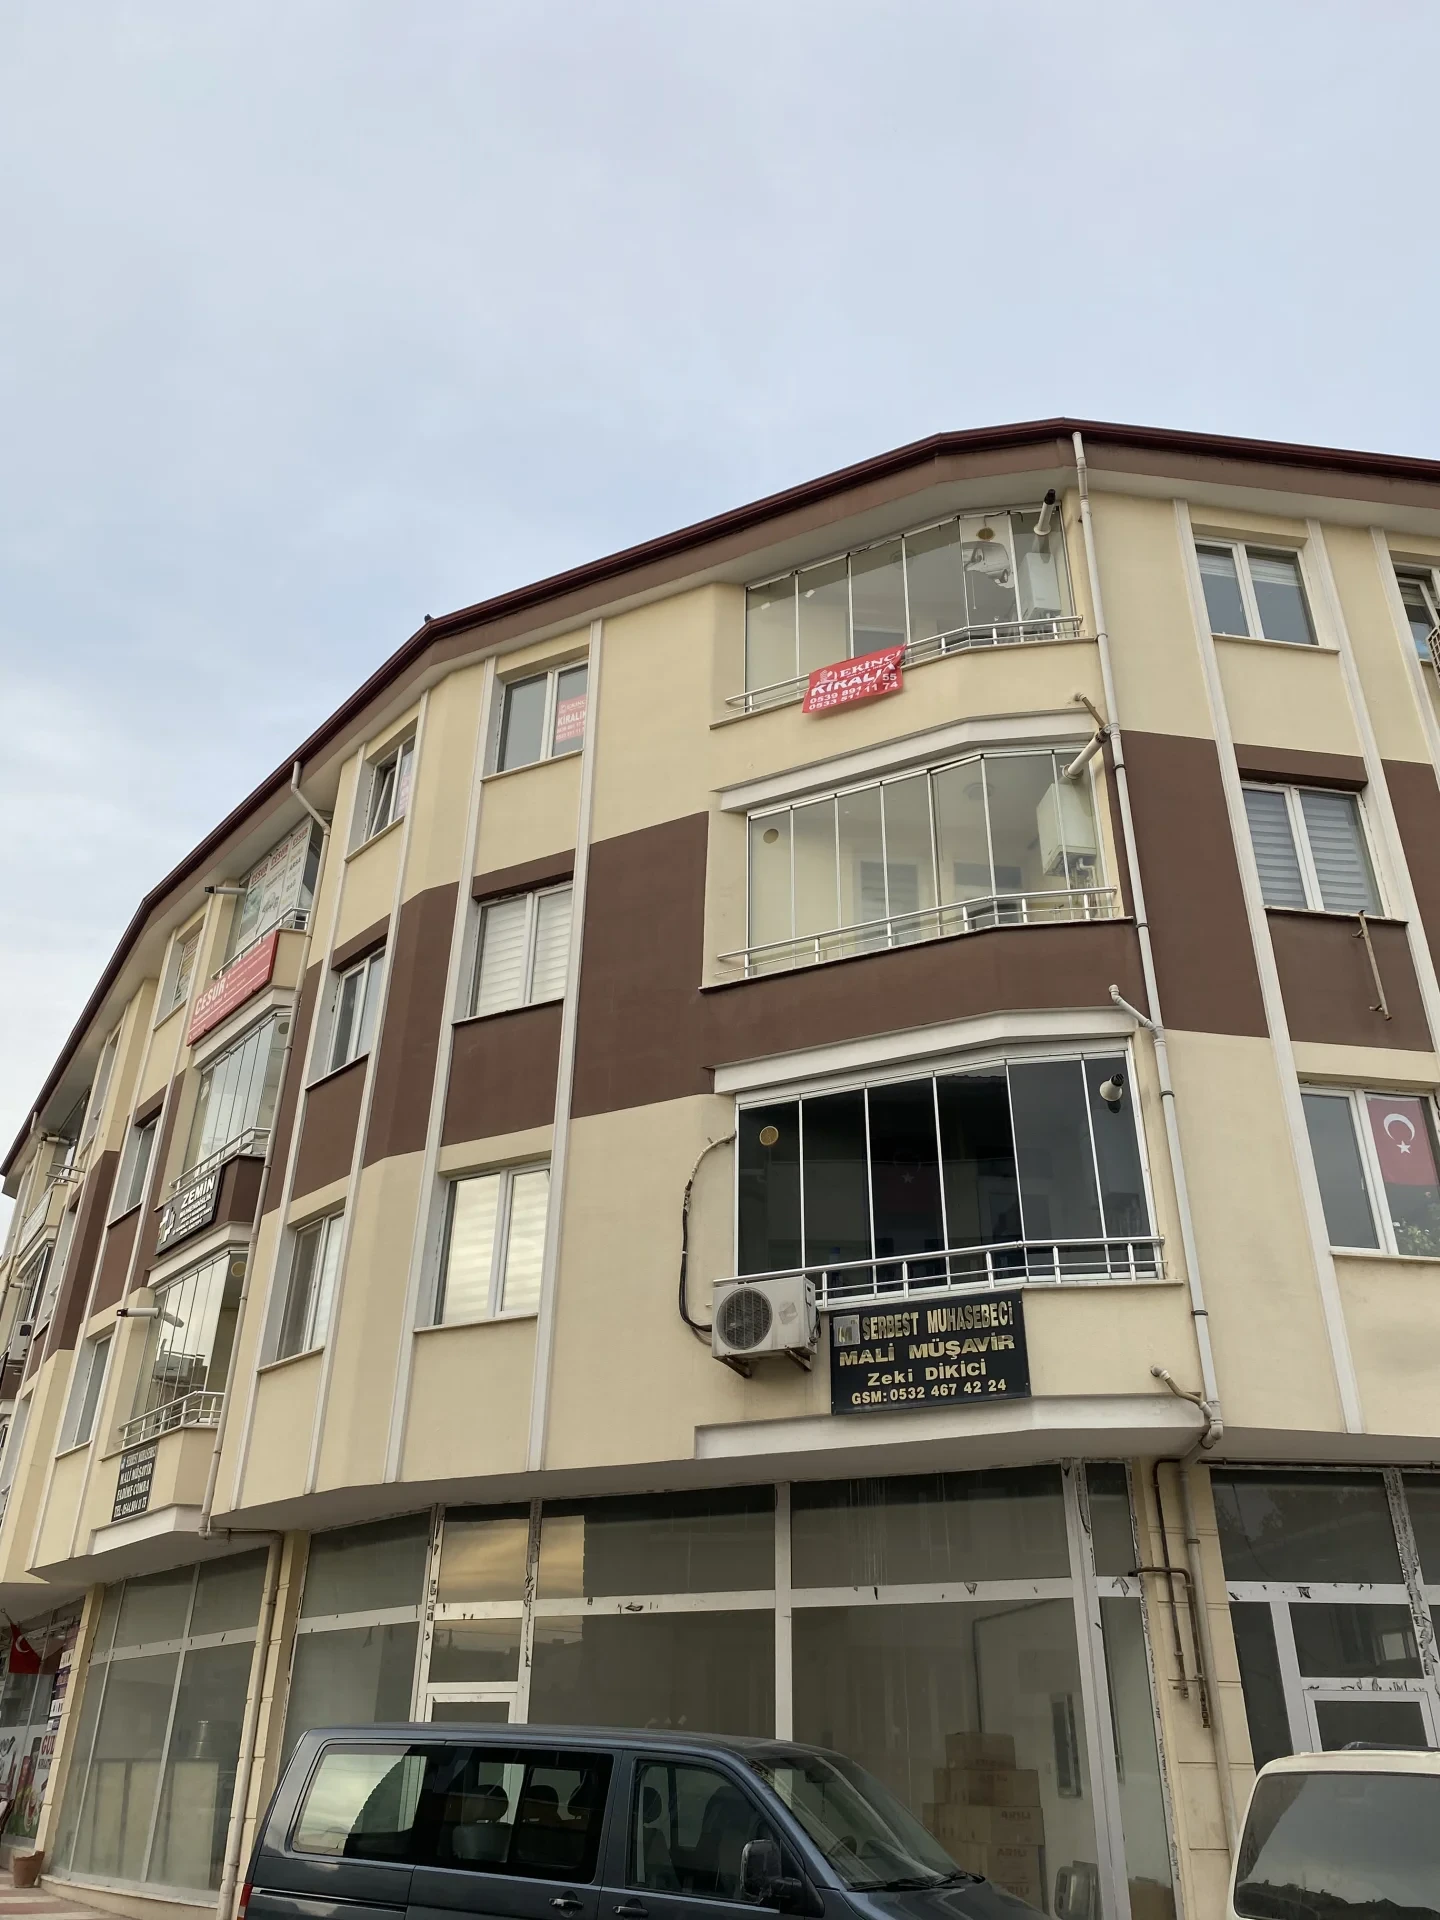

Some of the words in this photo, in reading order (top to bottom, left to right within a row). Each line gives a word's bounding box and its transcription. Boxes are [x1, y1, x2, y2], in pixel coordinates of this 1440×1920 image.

[809, 692, 838, 704] 0539
[882, 673, 897, 681] 55
[809, 699, 837, 711] 0533
[883, 681, 898, 690] 74
[194, 977, 227, 1016] CESUR
[181, 1174, 216, 1210] ZEMİN
[862, 1311, 920, 1341] SERBEST
[927, 1301, 1014, 1334] MUHASEBECİ
[839, 1342, 895, 1367] MALİ
[908, 1332, 1015, 1360] MÜŞAVİR
[867, 1368, 914, 1387] Zeki
[925, 1358, 987, 1381] DİKİCİ
[930, 1383, 957, 1397] 467
[963, 1381, 982, 1394] 42
[988, 1378, 1007, 1392] 24
